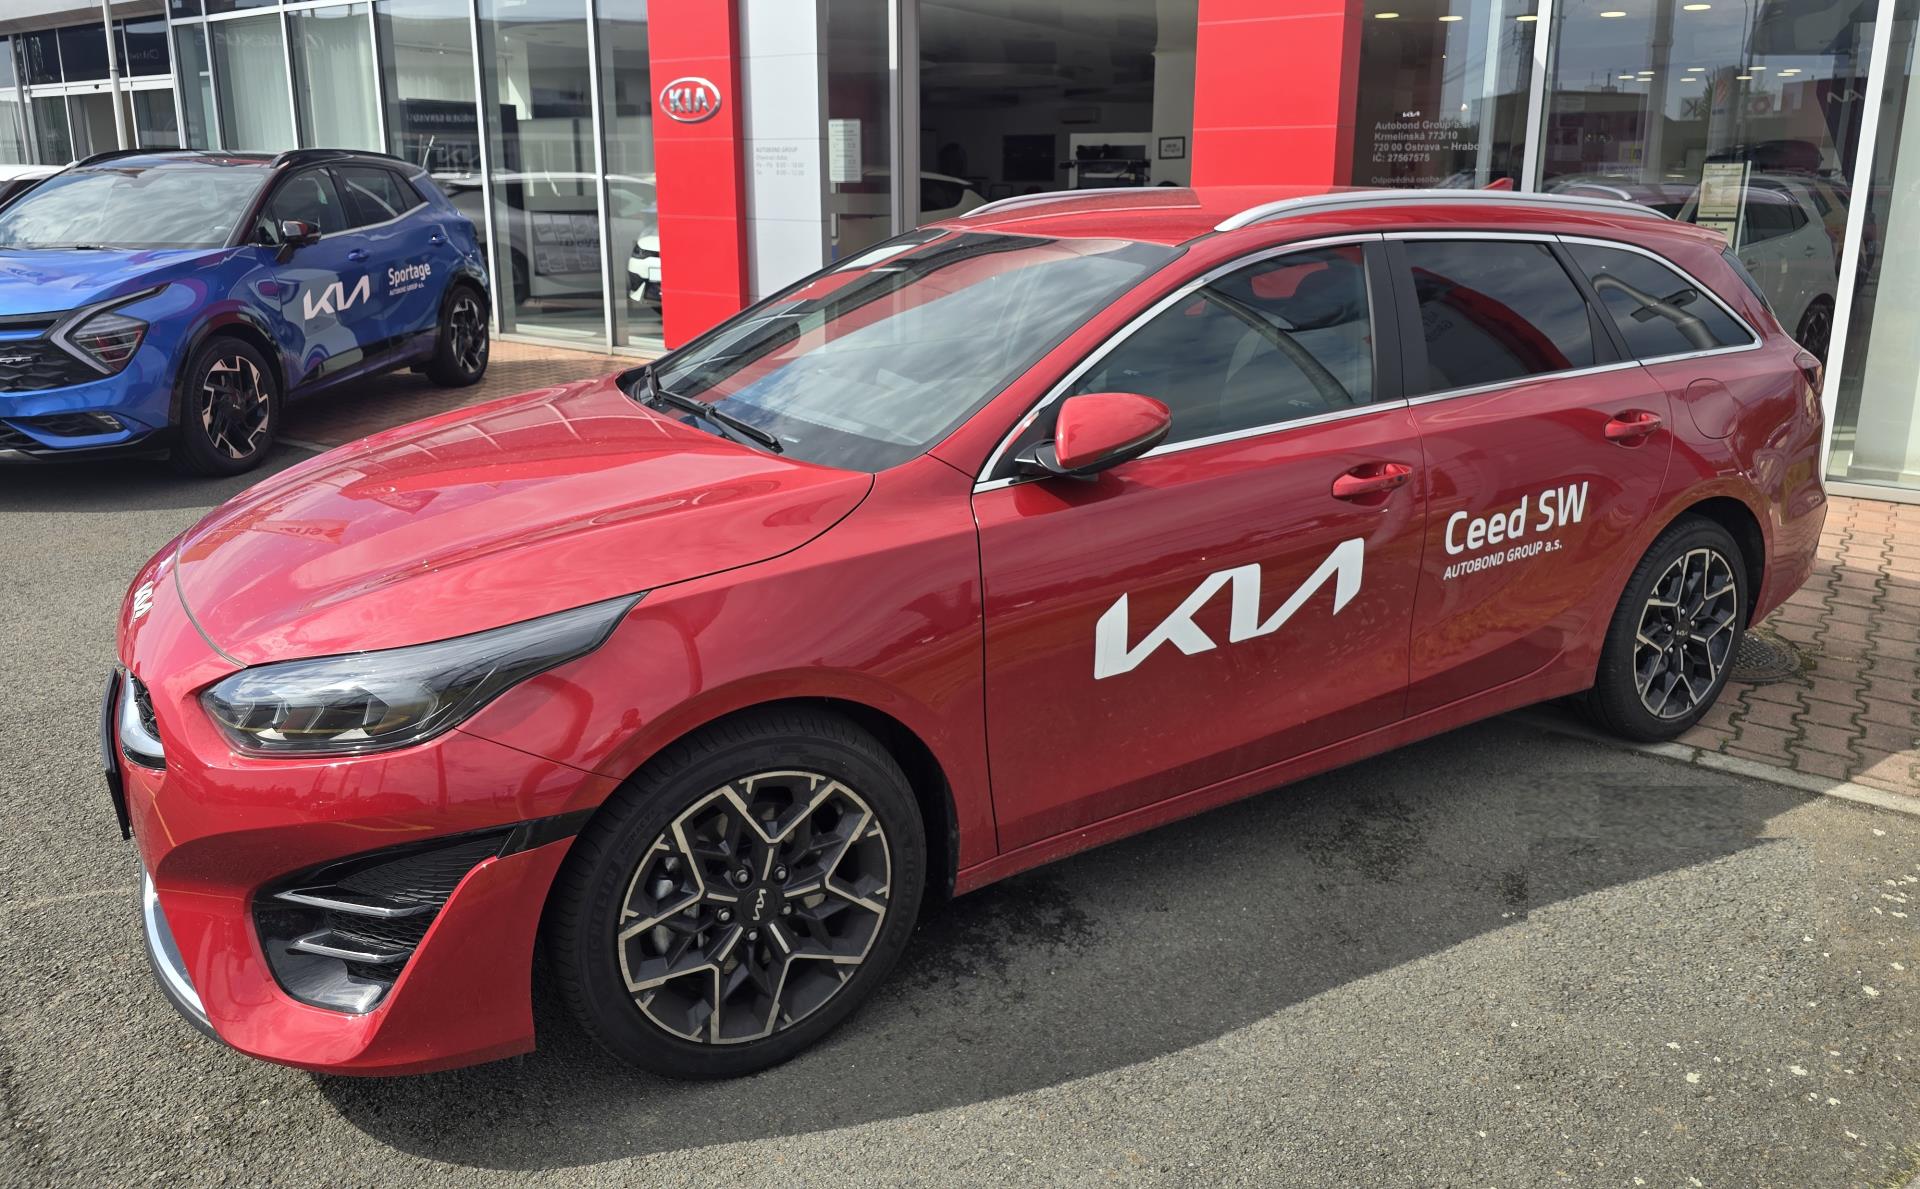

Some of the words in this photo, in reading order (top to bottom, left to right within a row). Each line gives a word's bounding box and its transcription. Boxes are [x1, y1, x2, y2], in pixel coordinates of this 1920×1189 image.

[668, 87, 711, 113] KIA
[1374, 131, 1425, 141] Krmelínská
[1428, 130, 1459, 141] 773/10
[1375, 121, 1420, 130] Autobond
[1422, 121, 1451, 131] Group
[1374, 143, 1389, 152] 720
[1391, 143, 1403, 151] 00
[1404, 142, 1441, 151] Ostrava
[388, 263, 432, 287] Sportage
[303, 275, 370, 320] KIA
[1445, 494, 1528, 555] Ceed
[1535, 481, 1589, 533] SW
[1442, 551, 1505, 581] AUTOBOND
[1505, 540, 1543, 563] GROUP
[1544, 539, 1562, 552] a.s.
[1094, 537, 1365, 680] KIA
